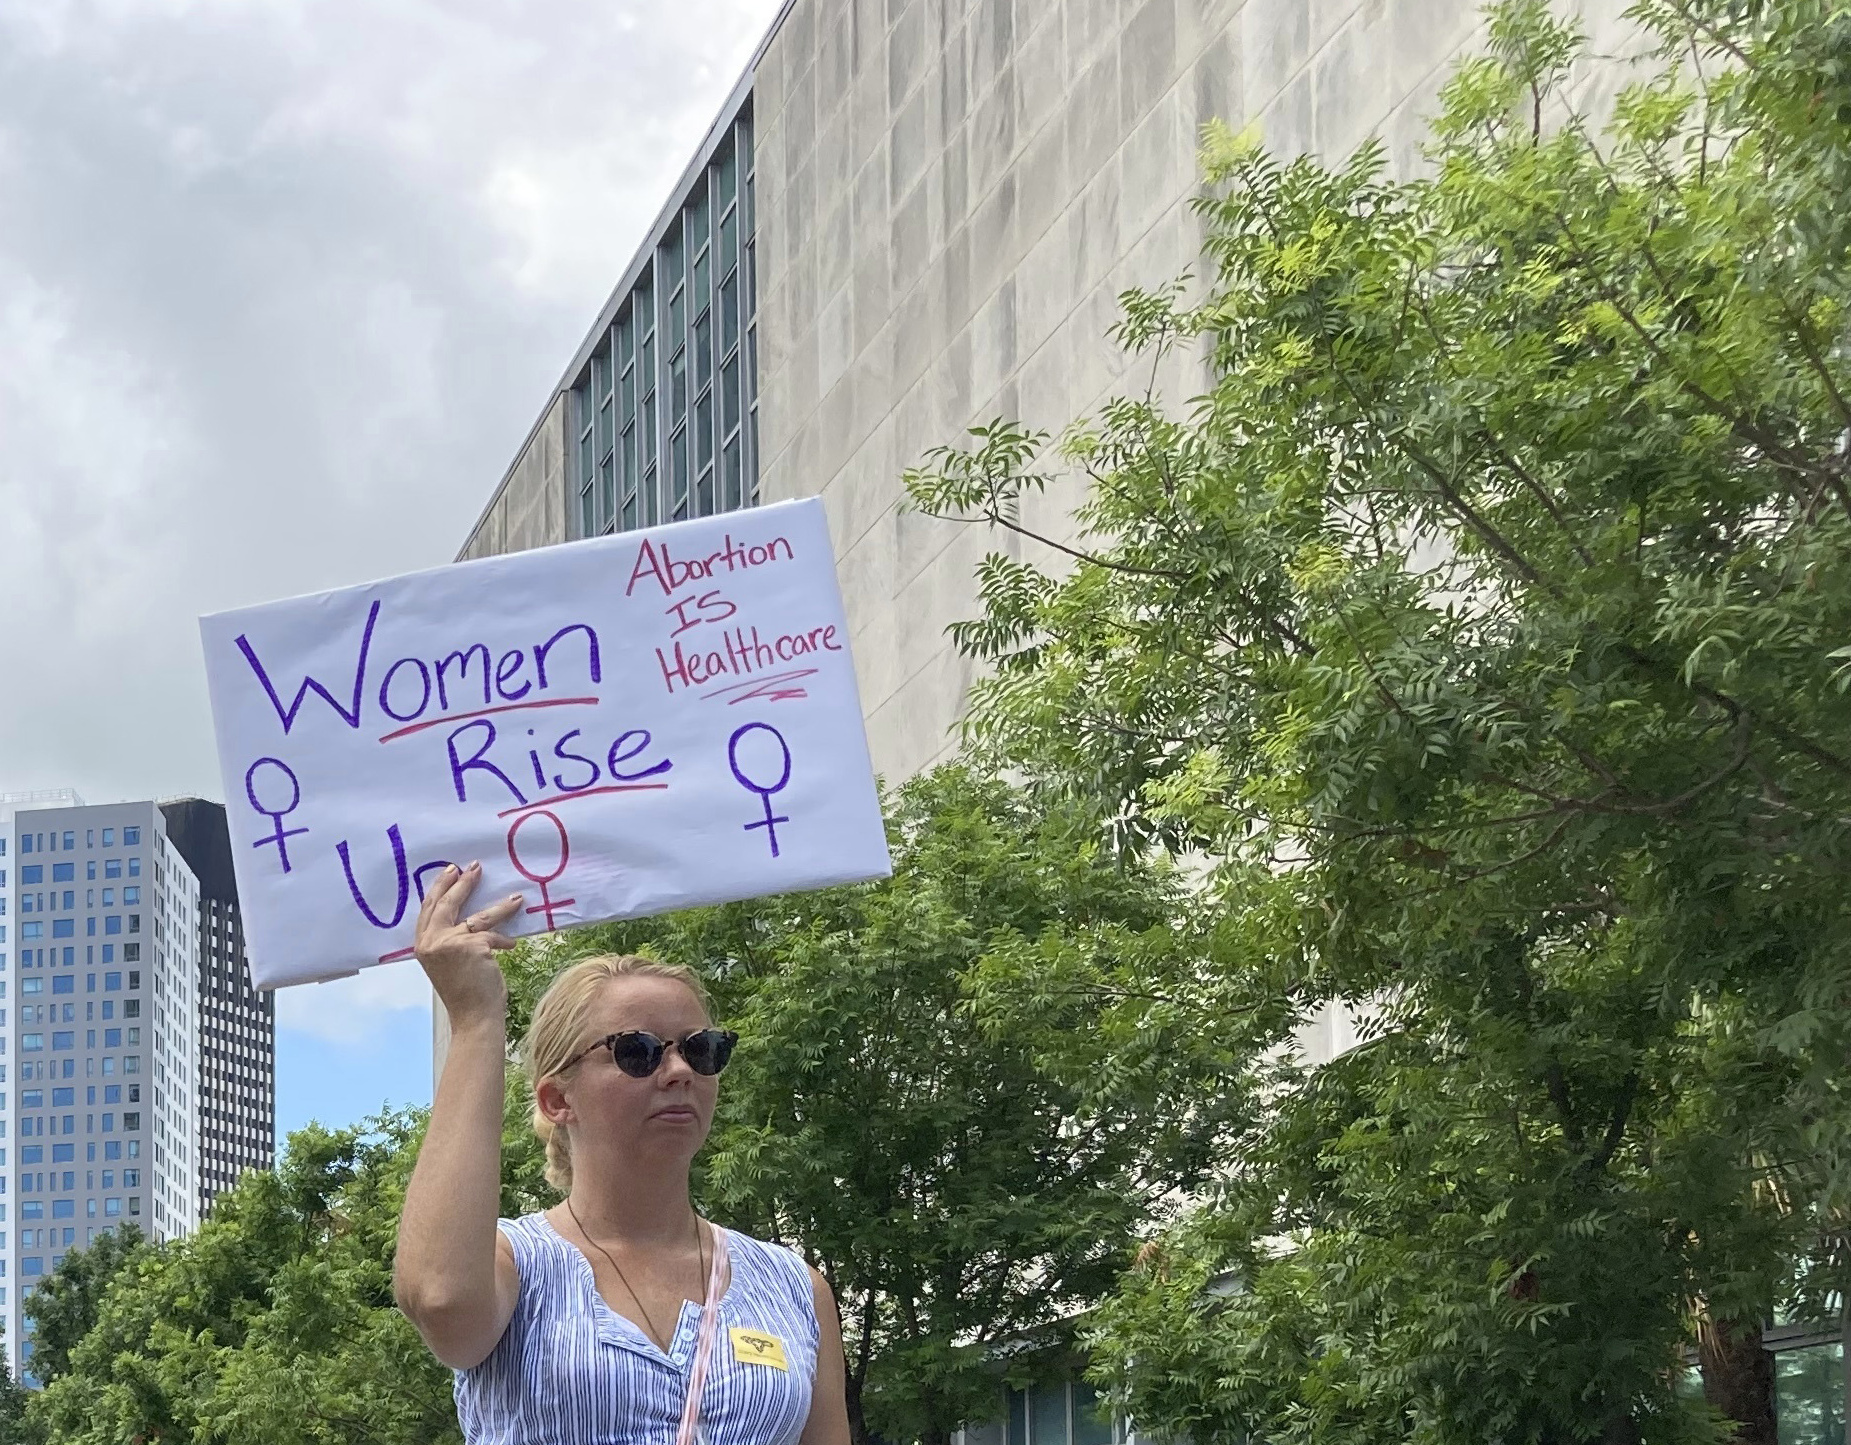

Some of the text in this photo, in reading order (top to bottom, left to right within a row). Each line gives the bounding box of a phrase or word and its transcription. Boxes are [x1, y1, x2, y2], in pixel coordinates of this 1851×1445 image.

[626, 534, 795, 596] Abortion
[665, 590, 737, 637] IS
[234, 600, 602, 735] Women
[655, 621, 843, 693] Healthcare
[447, 719, 674, 805] Rise
